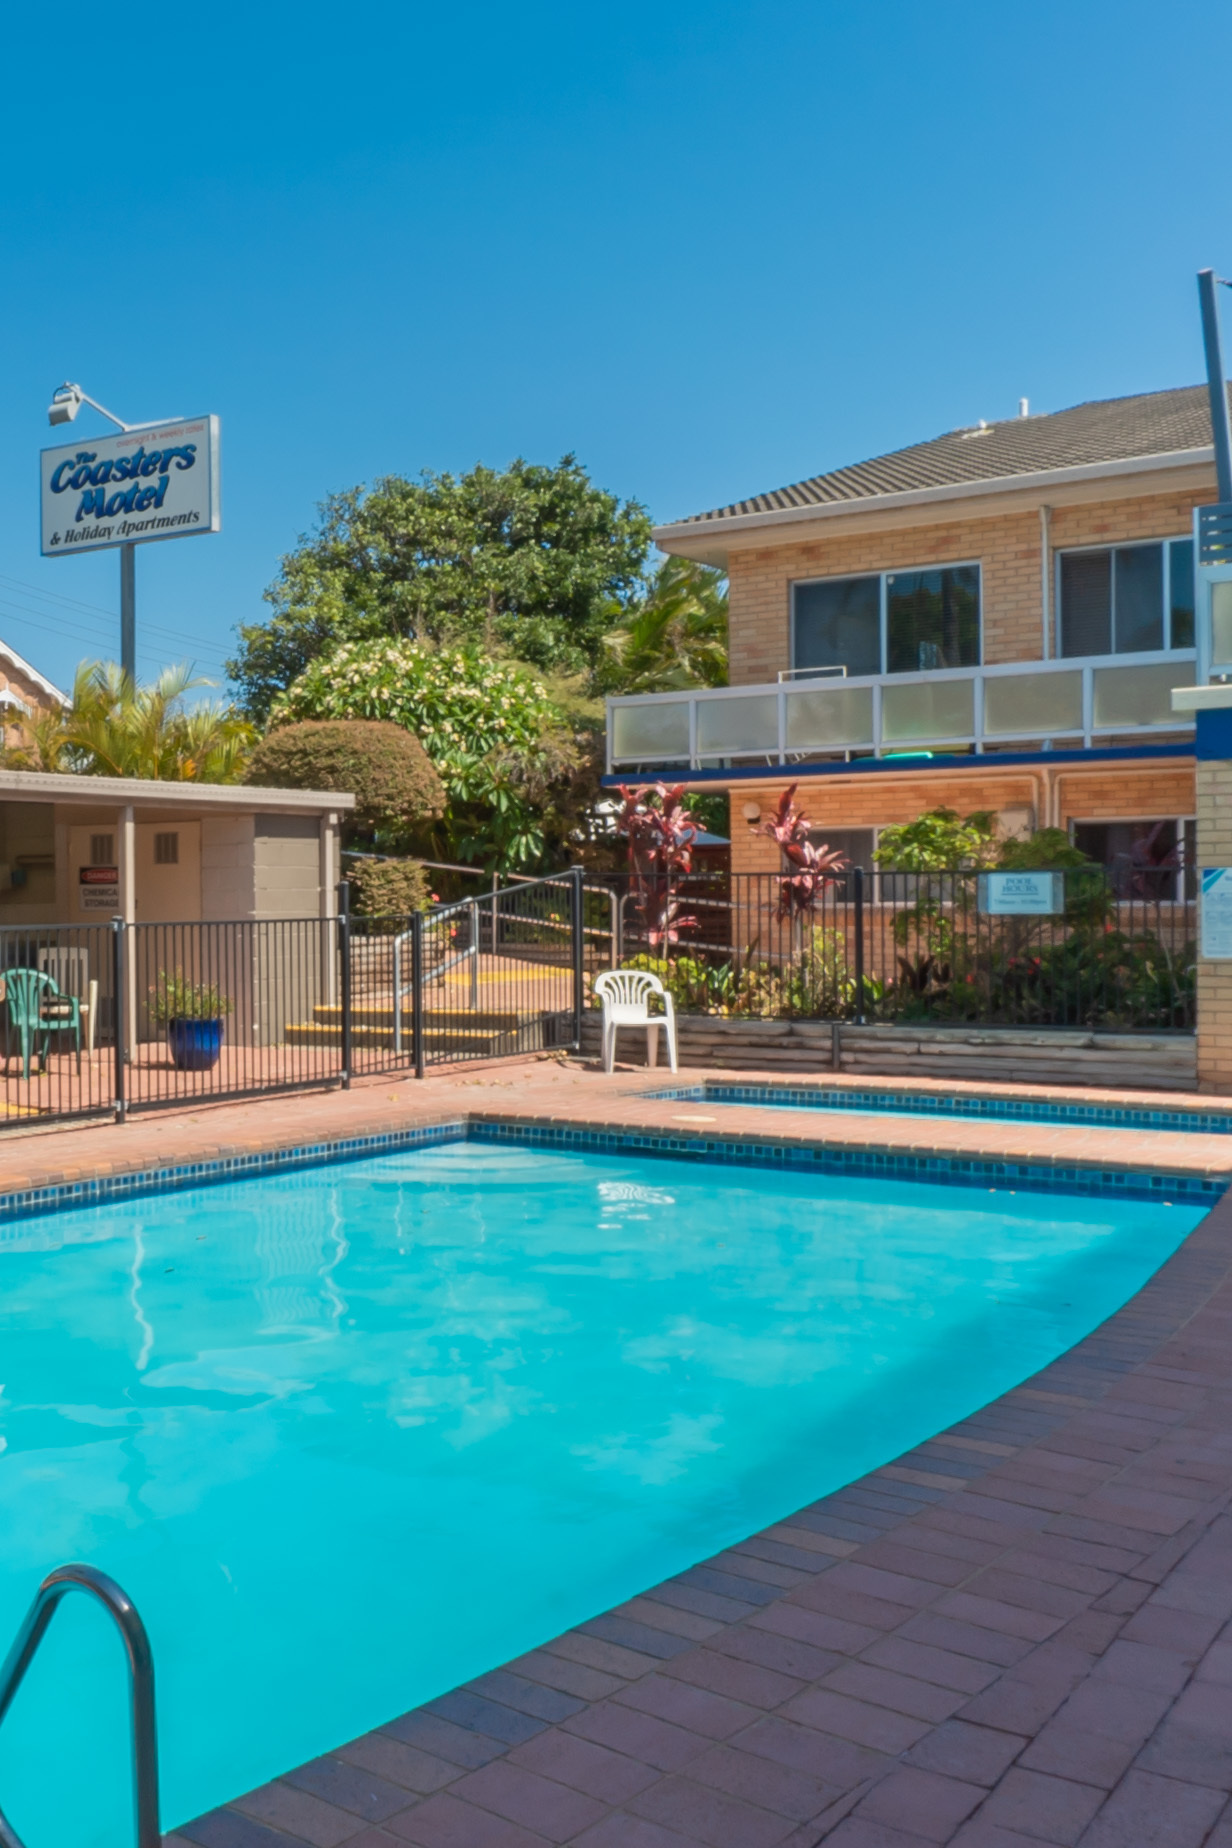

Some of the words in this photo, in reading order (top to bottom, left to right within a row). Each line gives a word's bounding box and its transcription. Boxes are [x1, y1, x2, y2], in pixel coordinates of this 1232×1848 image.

[50, 444, 197, 494] Coasters
[76, 451, 97, 465] The
[75, 475, 170, 523] Motel
[49, 531, 61, 546] &
[64, 523, 115, 544] Holiday
[117, 509, 200, 537] Apartments
[83, 888, 118, 896] CHEMICA
